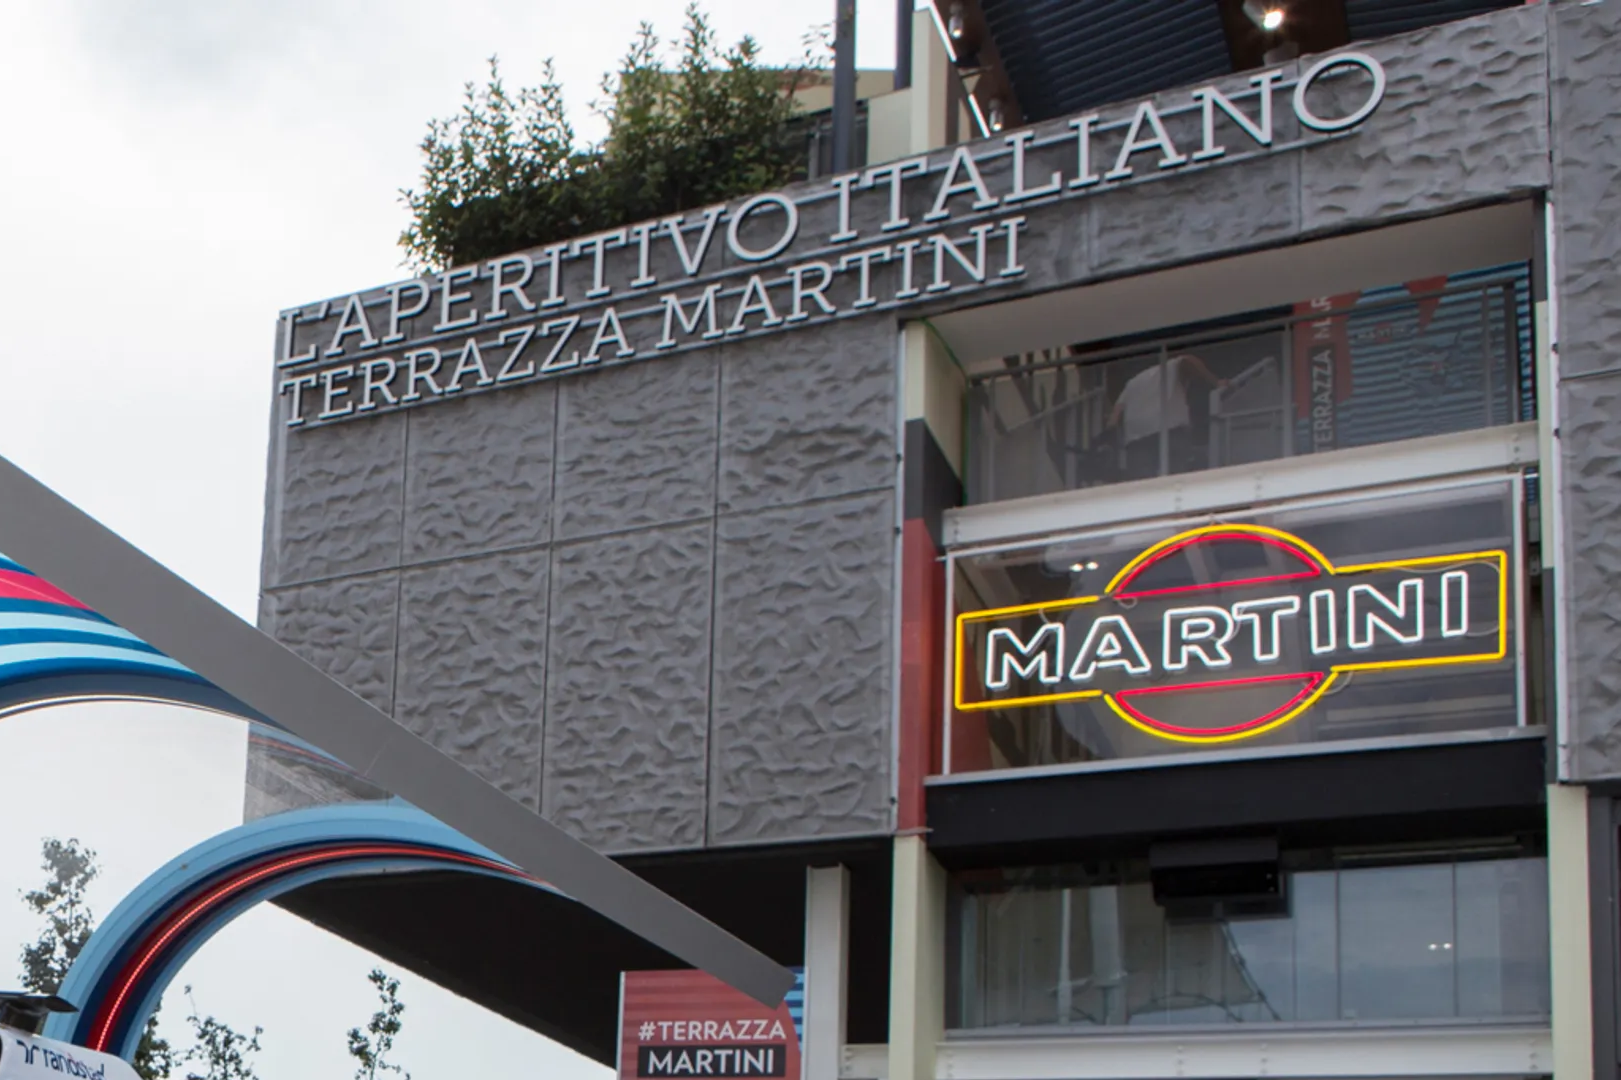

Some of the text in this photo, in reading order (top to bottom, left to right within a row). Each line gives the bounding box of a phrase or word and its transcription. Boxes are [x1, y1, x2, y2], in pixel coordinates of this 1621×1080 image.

[277, 52, 1385, 368] L'APERITIVO ITALIANO
[280, 216, 1027, 427] TERRAZZA MARTINI
[986, 571, 1468, 690] MARTINI
[638, 1019, 787, 1041] #TERRAZZA
[648, 1048, 775, 1075] MARTINI
